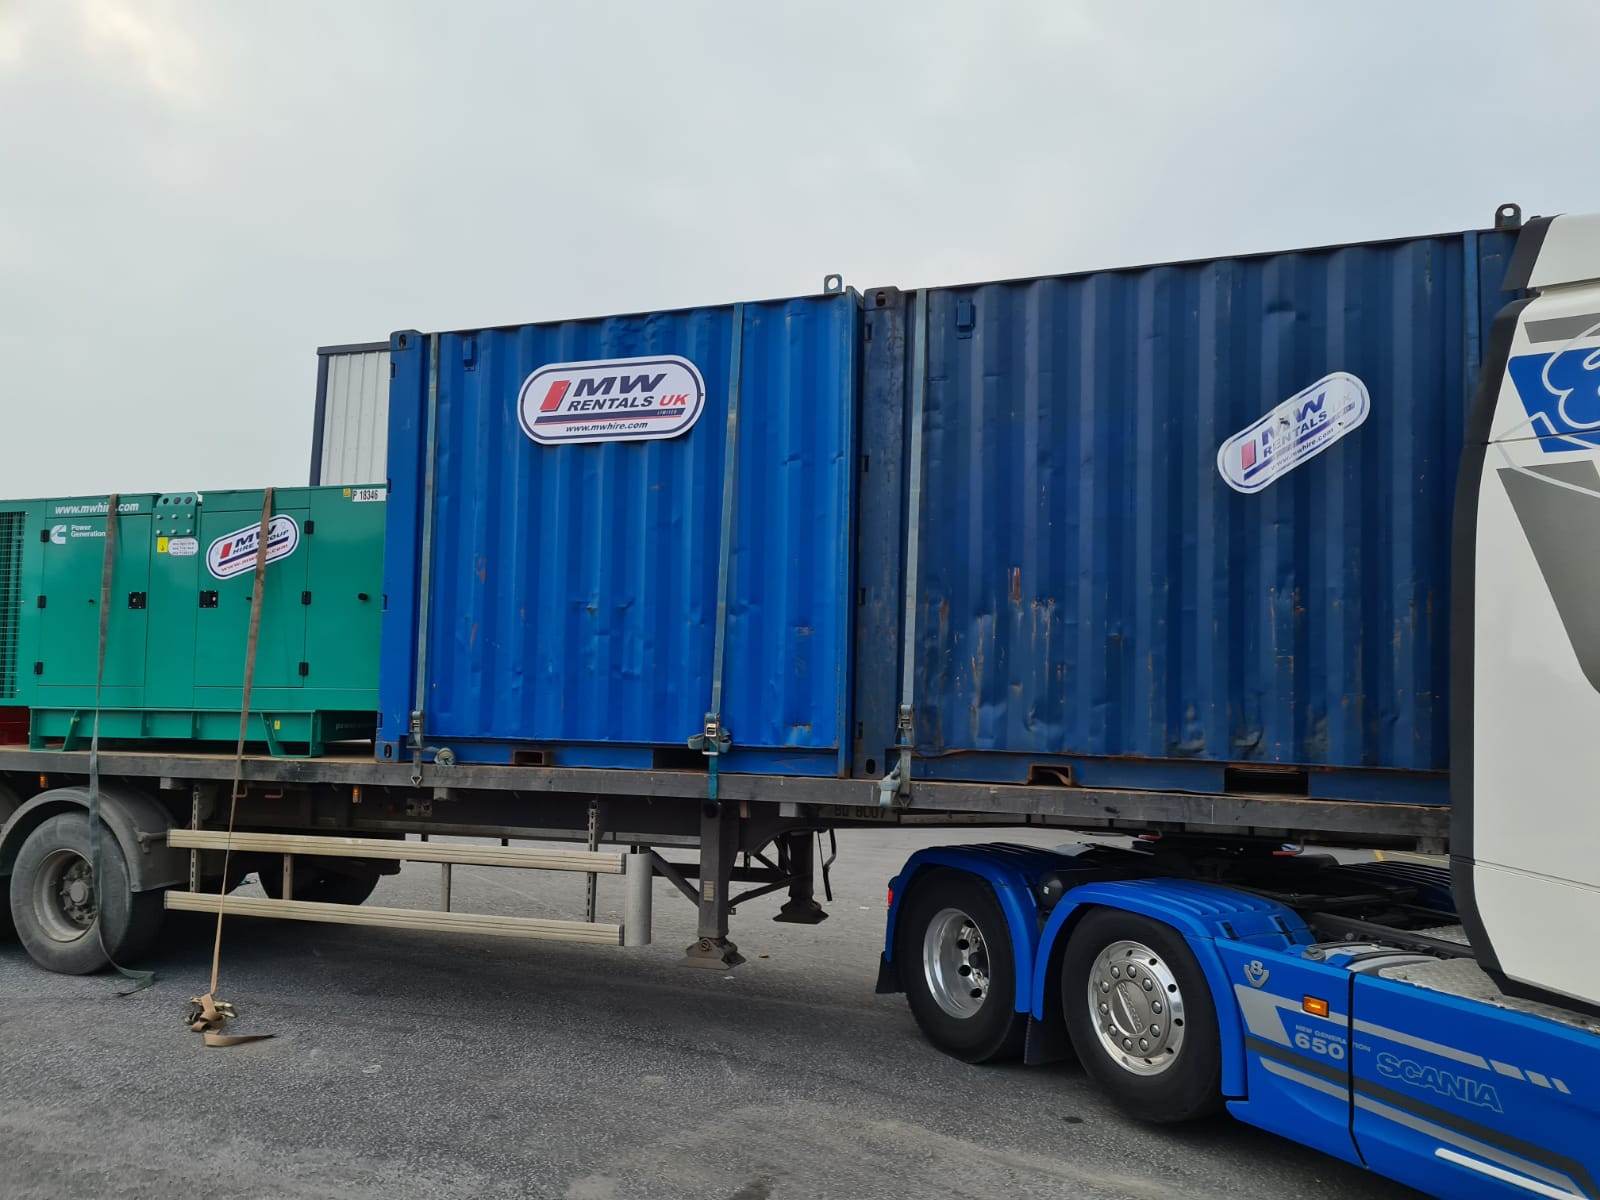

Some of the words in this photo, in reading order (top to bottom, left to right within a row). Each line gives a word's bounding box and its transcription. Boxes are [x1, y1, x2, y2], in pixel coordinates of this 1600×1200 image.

[573, 373, 668, 397] MW
[567, 395, 654, 412] RENTALS
[659, 393, 690, 407] UK
[565, 420, 648, 433] www.mwhire.com
[1263, 410, 1328, 458] RENTALS
[70, 530, 106, 538] Generation
[71, 524, 92, 532] Power
[233, 542, 255, 554] HIRE
[1295, 1024, 1313, 1034] NEW
[1294, 1032, 1345, 1060] 650
[1376, 1051, 1504, 1115] SCANIA
